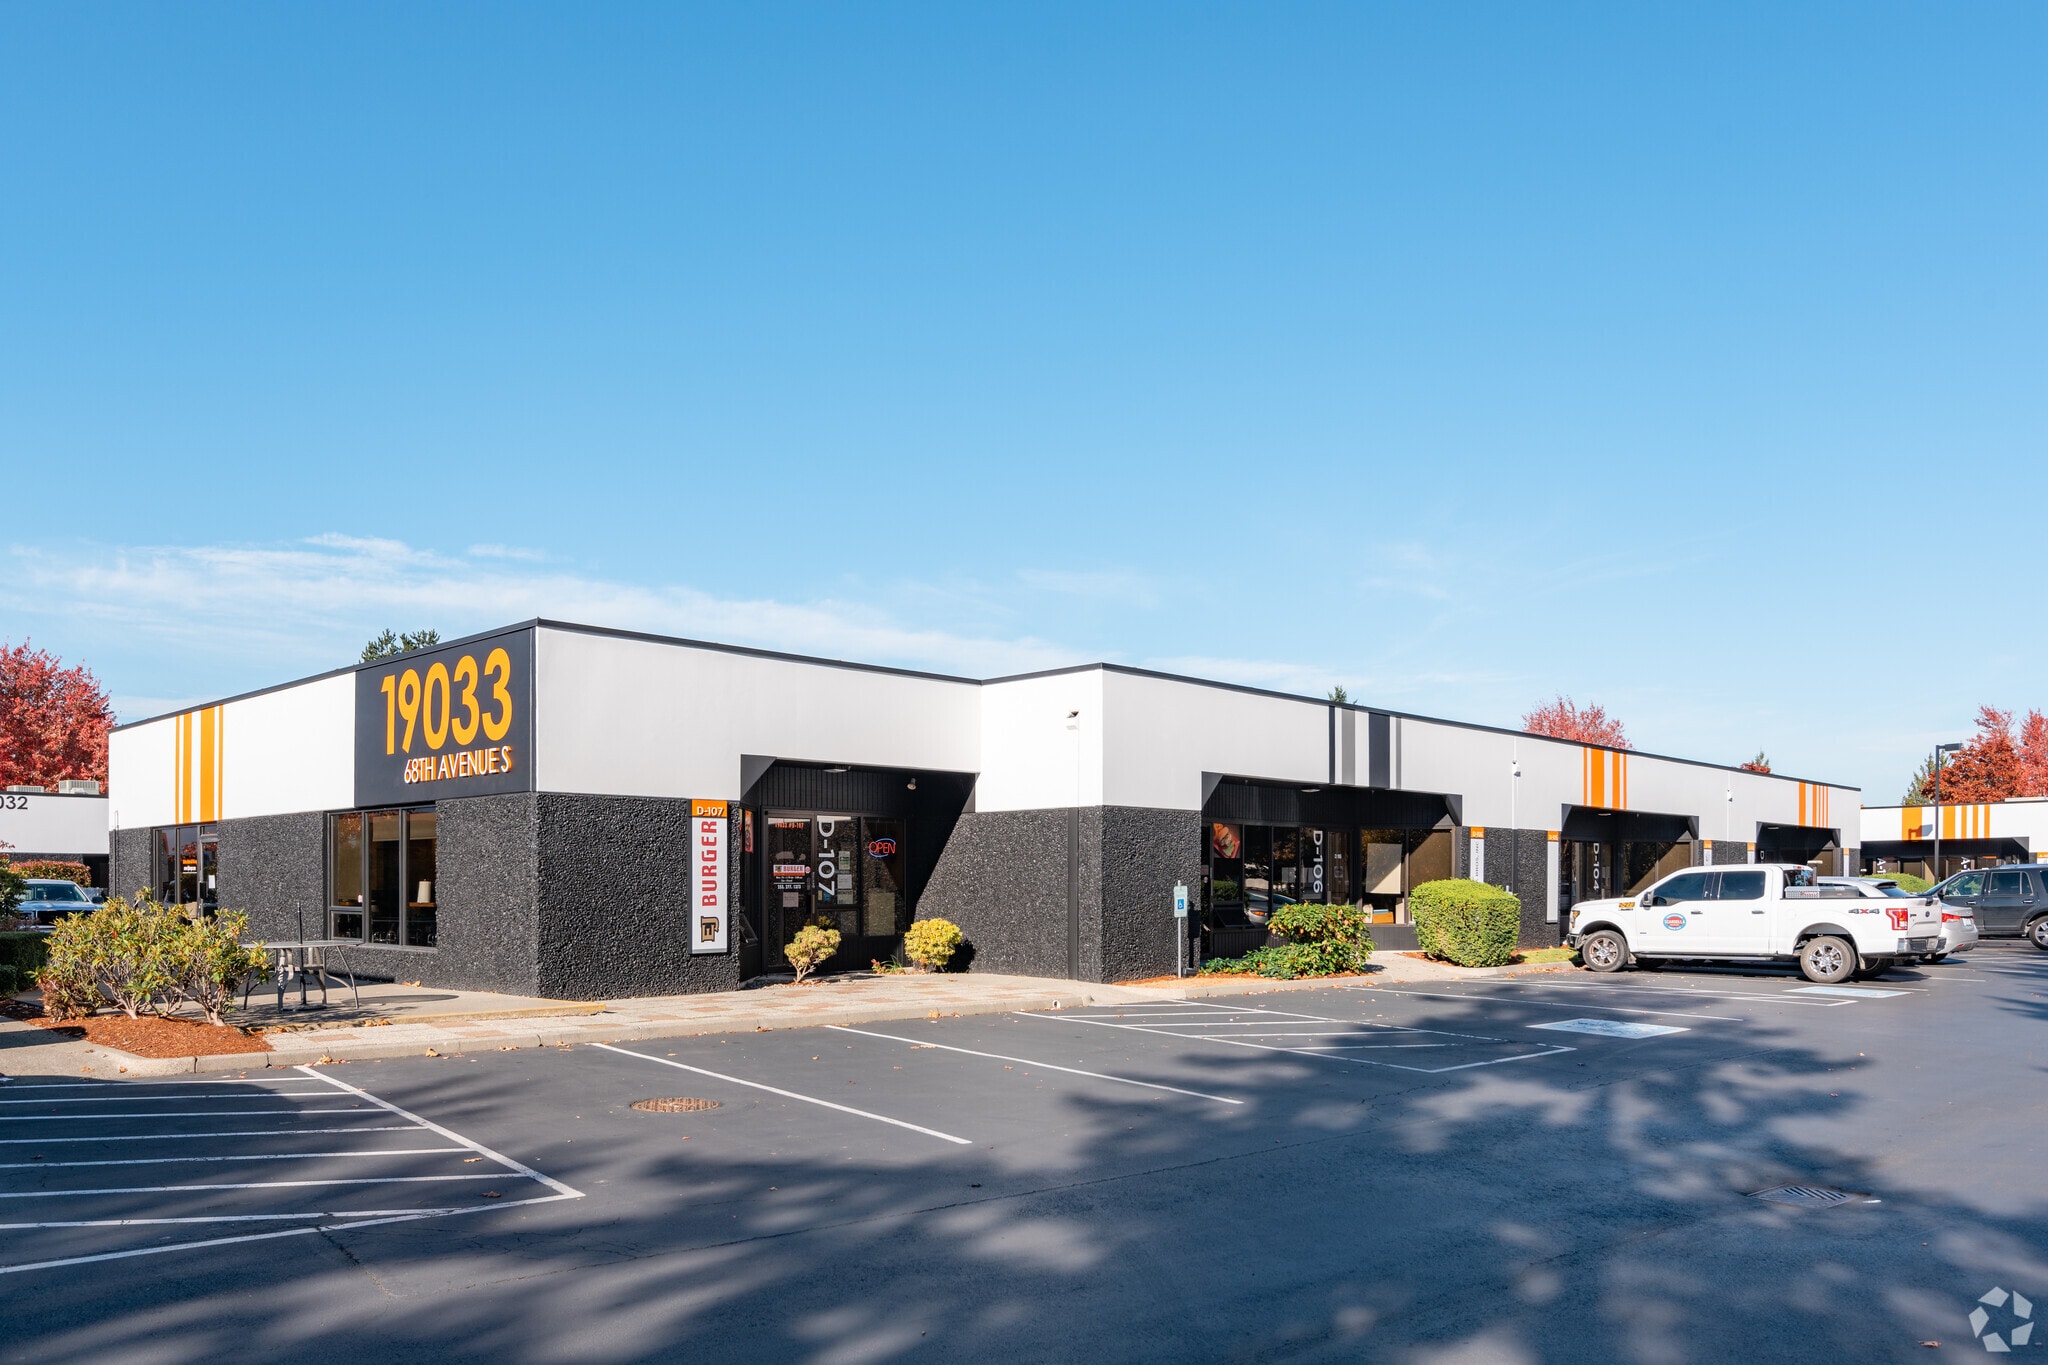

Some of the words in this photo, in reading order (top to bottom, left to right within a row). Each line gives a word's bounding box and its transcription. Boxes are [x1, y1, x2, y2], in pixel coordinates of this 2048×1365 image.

[380, 647, 513, 755] 19033
[404, 756, 437, 784] 68TH
[437, 747, 501, 781] AVENUE
[501, 745, 513, 774] S
[696, 806, 724, 816] D-107
[701, 821, 717, 906] BURGER
[818, 818, 835, 896] D-107
[868, 841, 896, 854] OPEN
[1313, 830, 1323, 893] D-106
